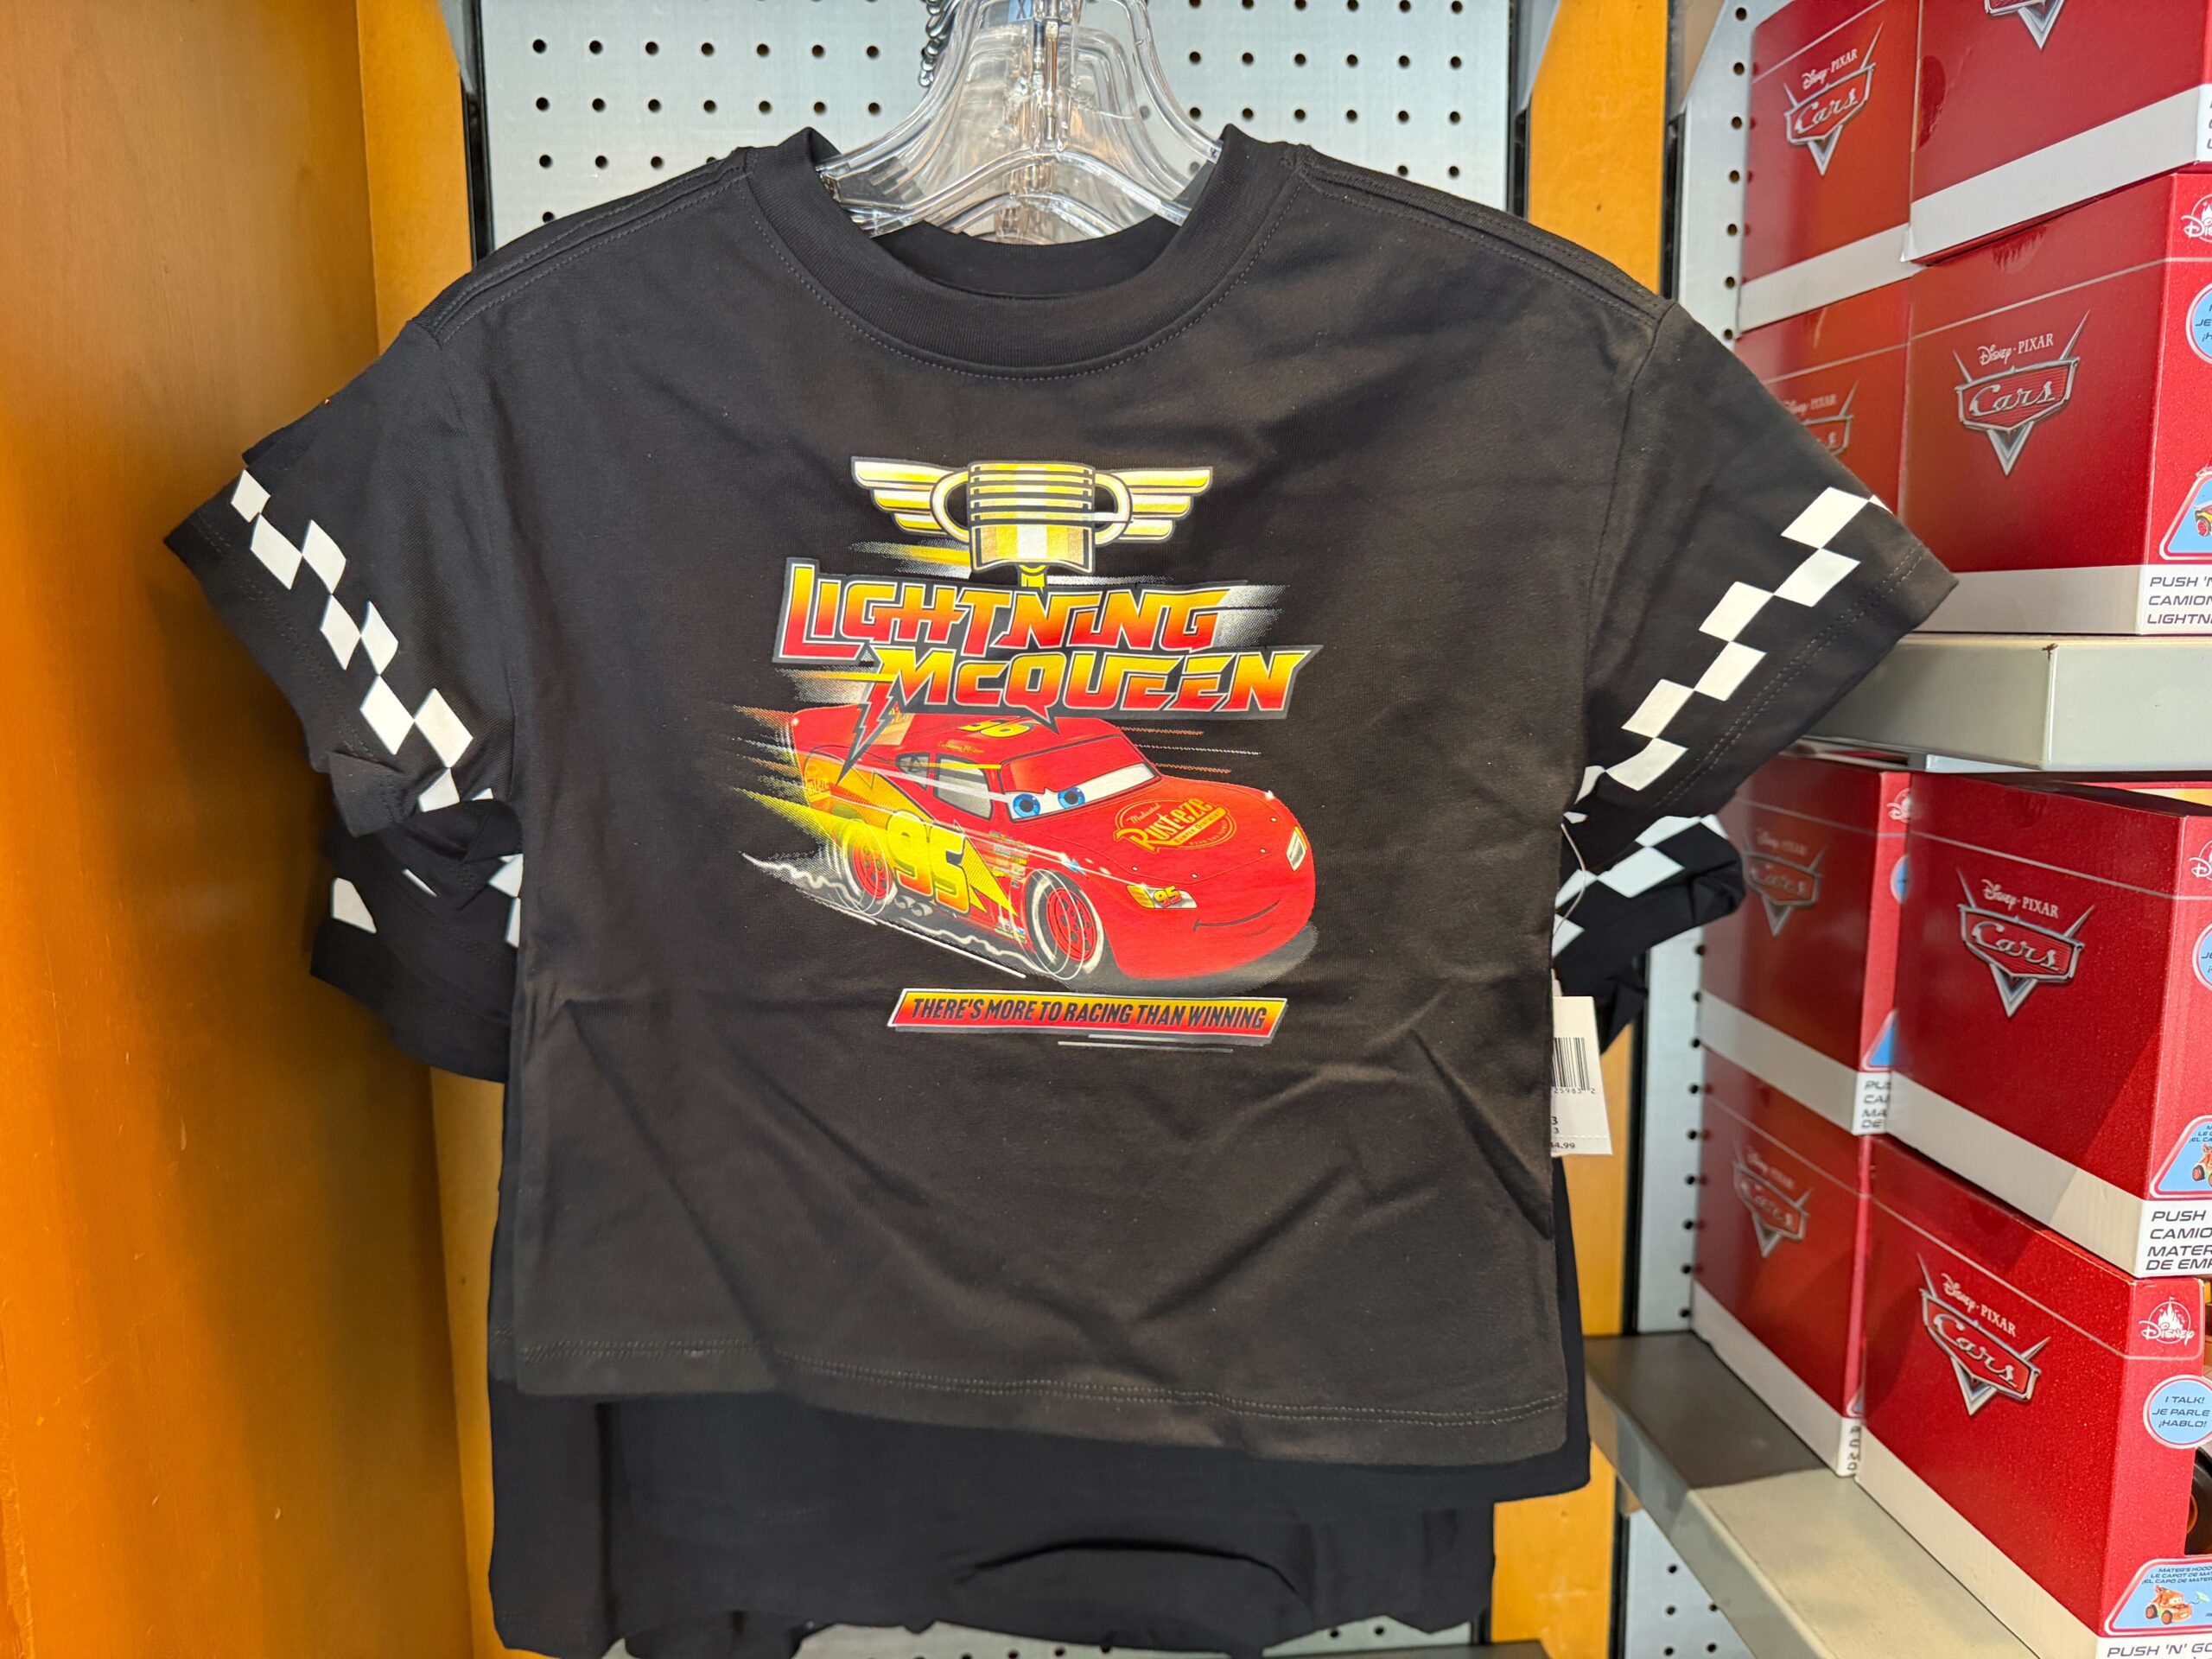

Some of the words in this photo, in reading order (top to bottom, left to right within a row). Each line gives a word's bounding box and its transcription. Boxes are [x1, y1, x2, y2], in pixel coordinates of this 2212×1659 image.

[1830, 48, 1858, 73] PIXAR
[1794, 87, 1859, 135] Cars
[1977, 344, 2012, 366] Disney
[2018, 333, 2054, 354] PIXAR
[1968, 380, 2056, 416] Cars
[2150, 576, 2198, 588] PUSH
[780, 563, 1241, 660] LIGHTNING
[2147, 614, 2212, 625] LIGHTN
[887, 810, 969, 914] 95
[1154, 886, 1183, 907] 95
[1981, 879, 2017, 911] Disney
[2021, 897, 2059, 918] PIXAR
[1971, 921, 2060, 973] Cars
[912, 998, 985, 1020] THERE'S
[984, 1000, 1038, 1021] MORE
[1039, 1001, 1063, 1022] TO
[1062, 1002, 1134, 1025] RACING
[1135, 1004, 1187, 1027] THAN
[1187, 1005, 1268, 1030] WINNING
[2152, 1211, 2207, 1223] PUSH
[2145, 1260, 2174, 1271] DE
[1941, 1273, 1977, 1313] Disney
[1980, 1304, 2017, 1338] PIXAR
[2139, 1319, 2196, 1346] Disney
[1933, 1313, 2019, 1389] Cars
[2170, 1408, 2211, 1417] PARLE
[2107, 1645, 2160, 1657] PUSH
[2166, 1643, 2188, 1656] 'N'
